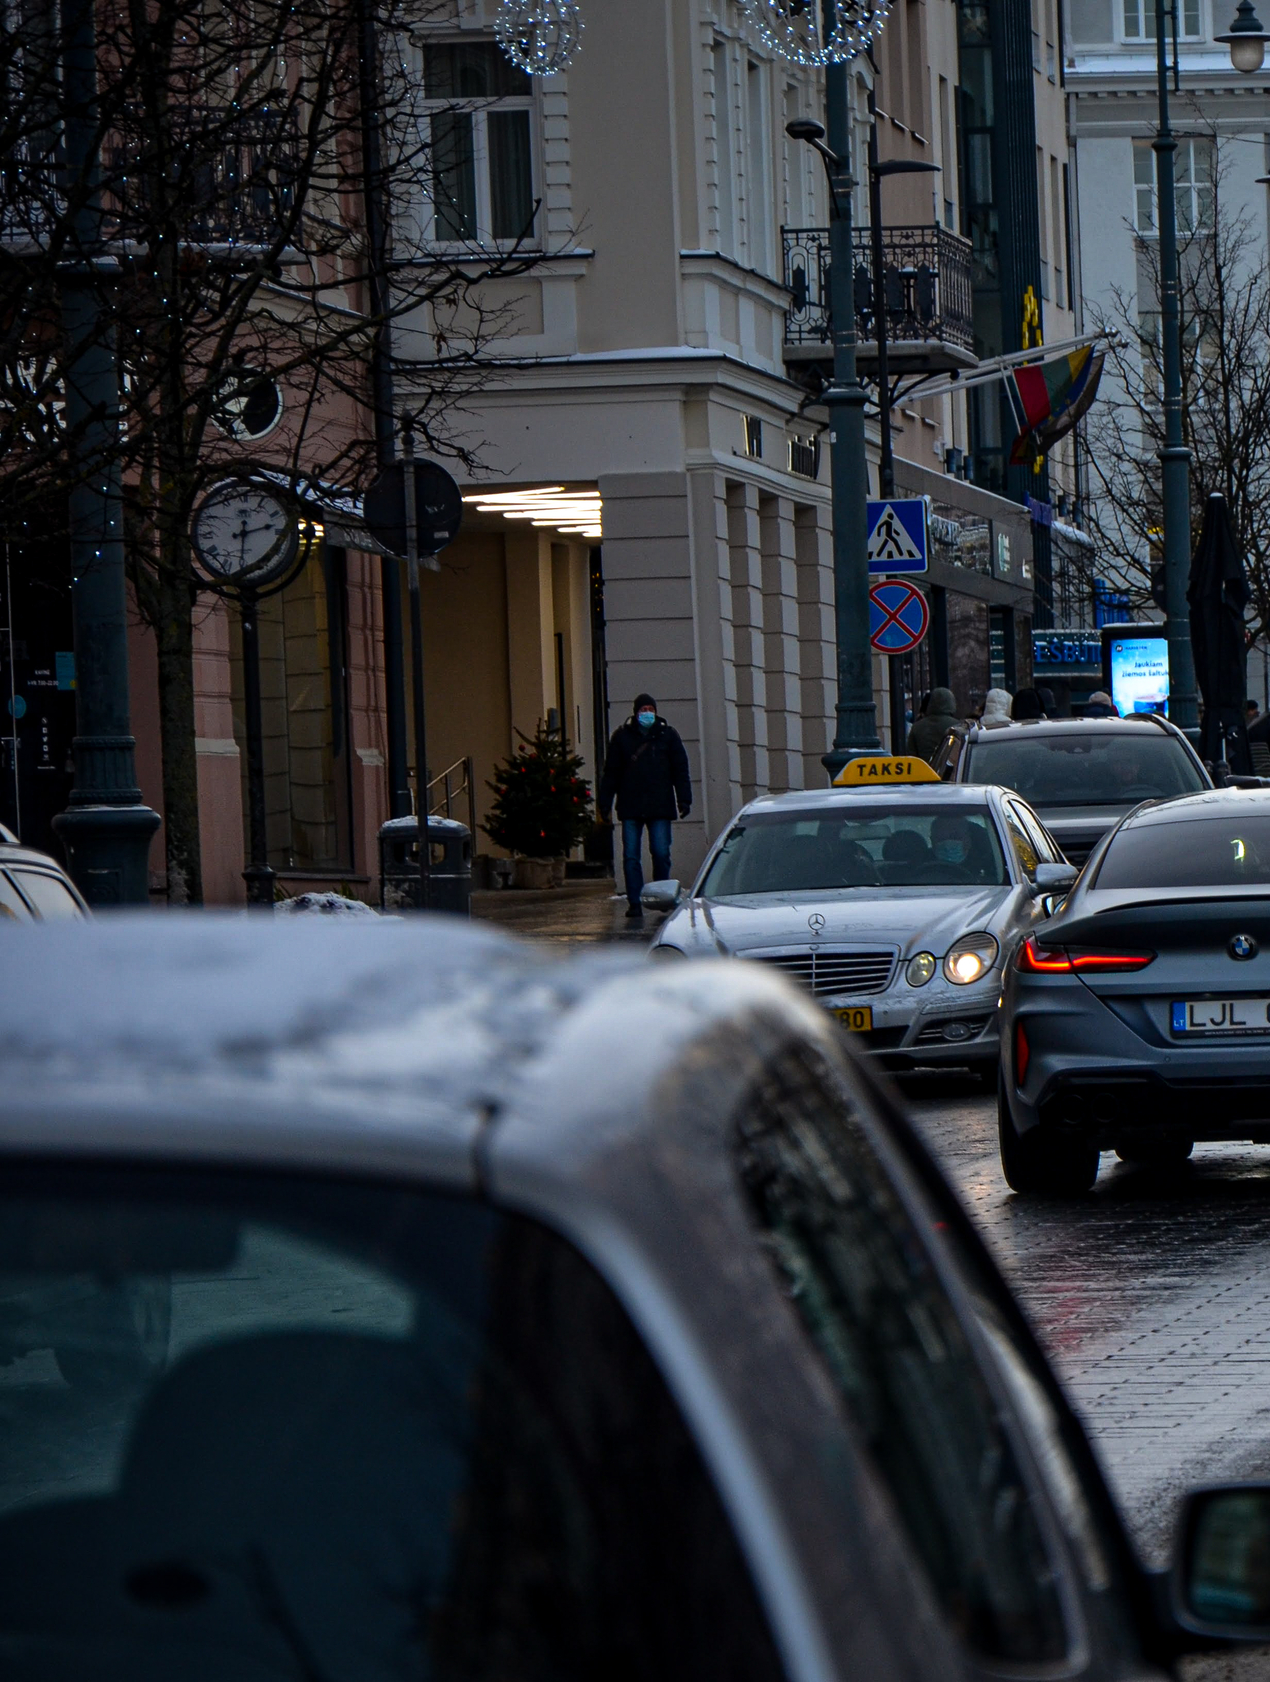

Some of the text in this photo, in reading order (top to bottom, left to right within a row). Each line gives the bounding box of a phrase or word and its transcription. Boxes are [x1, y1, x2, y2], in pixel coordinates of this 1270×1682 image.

[857, 762, 912, 776] TAKSI
[1189, 1003, 1246, 1027] LJL
[1174, 1019, 1185, 1028] LT
